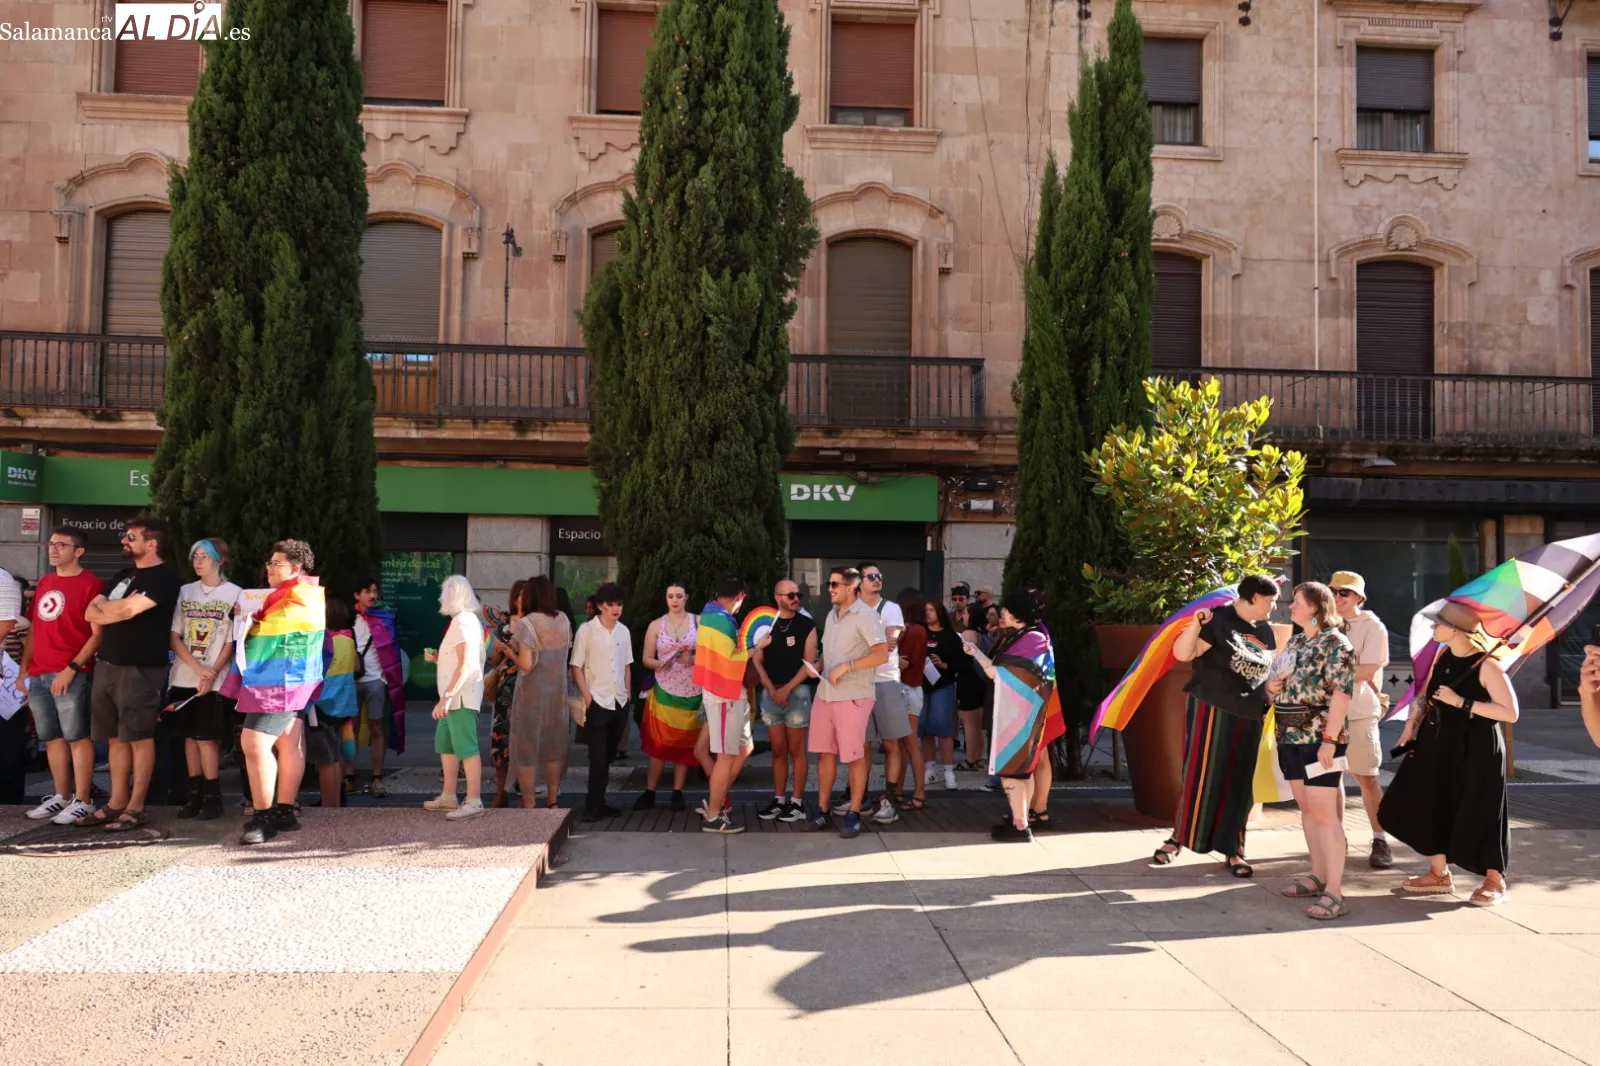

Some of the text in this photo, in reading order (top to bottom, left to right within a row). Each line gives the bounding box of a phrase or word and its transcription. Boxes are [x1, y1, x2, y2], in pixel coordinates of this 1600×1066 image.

[7, 466, 38, 481] DKV
[790, 484, 857, 502] DKV
[109, 518, 125, 531] de
[558, 528, 602, 542] Espacio
